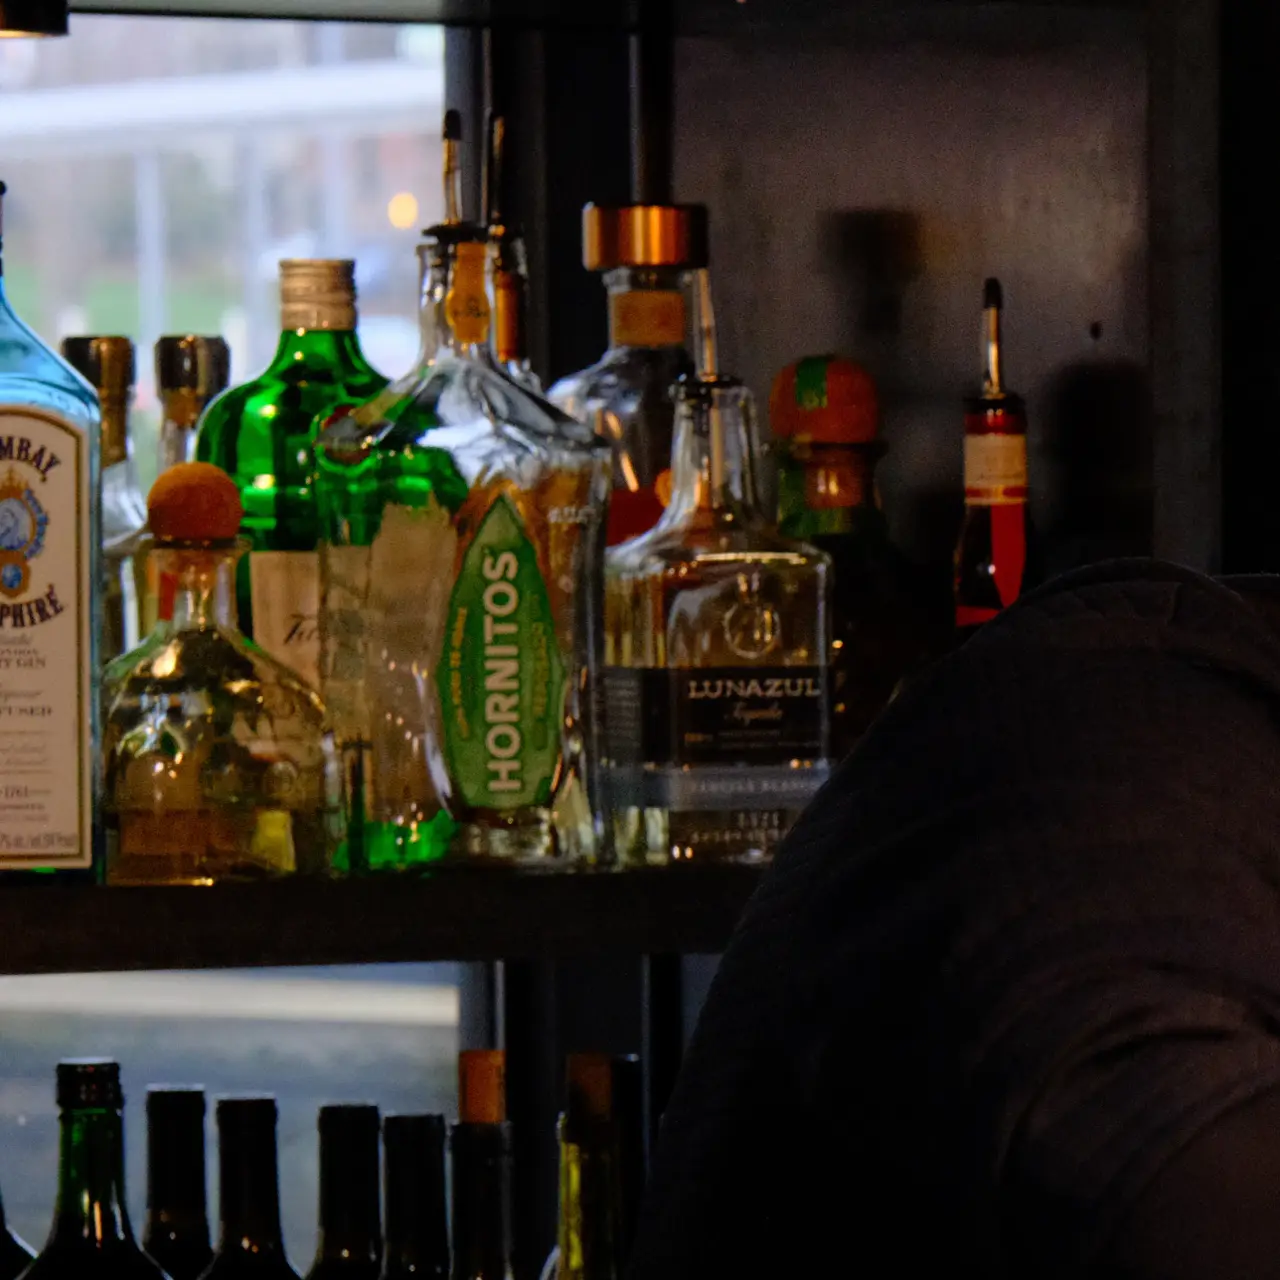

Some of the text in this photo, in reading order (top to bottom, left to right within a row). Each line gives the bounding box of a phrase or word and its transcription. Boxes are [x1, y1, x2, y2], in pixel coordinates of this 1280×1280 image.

[0, 435, 61, 483] MBAY
[0, 583, 64, 628] PHIRE
[482, 552, 521, 792] HORNITOS
[688, 678, 822, 699] LUNAZUL
